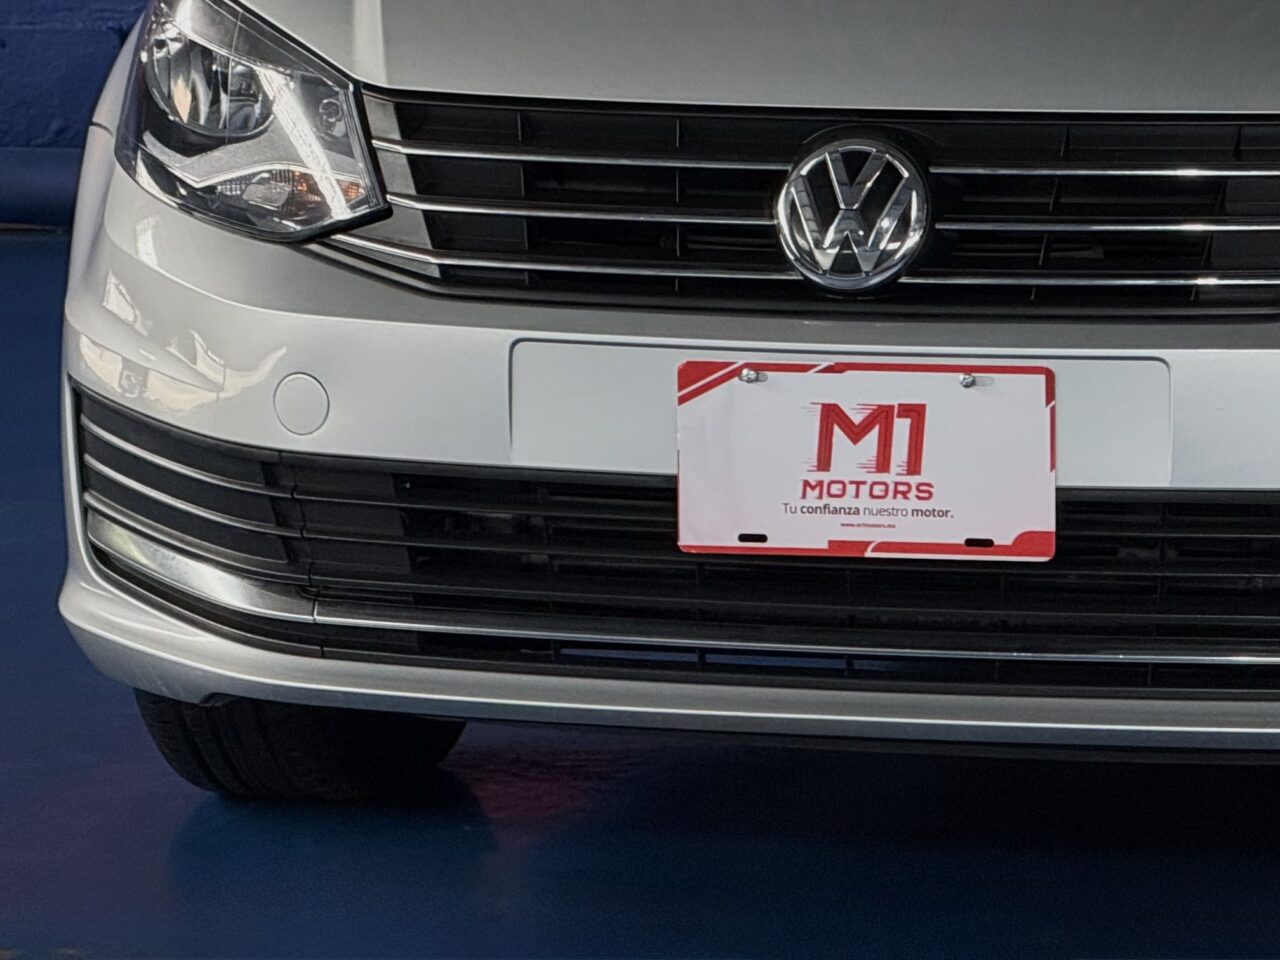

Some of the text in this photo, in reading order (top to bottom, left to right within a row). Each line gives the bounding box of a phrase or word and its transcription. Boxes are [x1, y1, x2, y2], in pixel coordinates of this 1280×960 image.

[806, 401, 928, 476] M1
[800, 479, 935, 501] MOTORS
[782, 503, 954, 519] Tu confianza nuestro motor.
